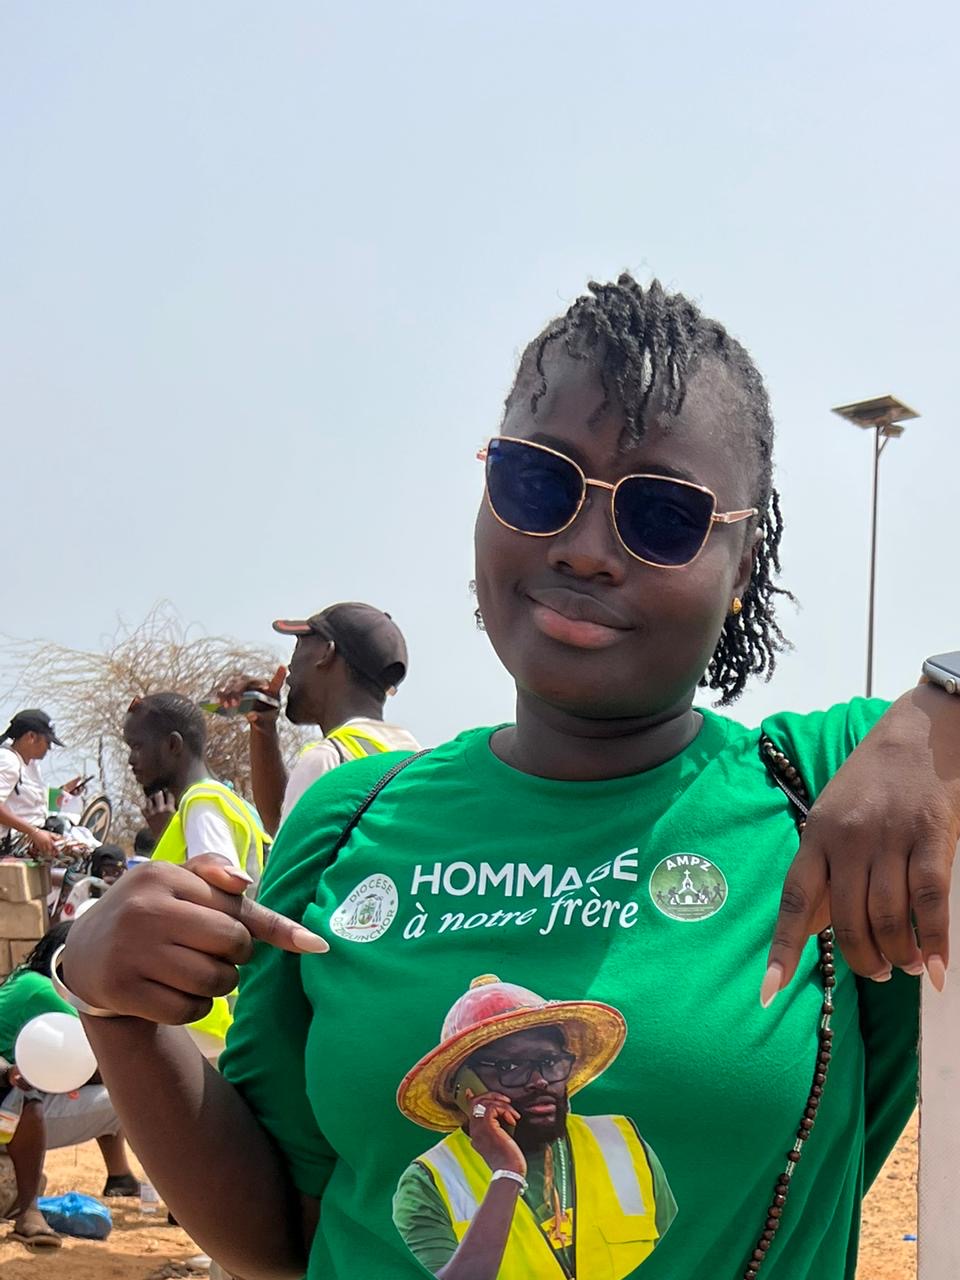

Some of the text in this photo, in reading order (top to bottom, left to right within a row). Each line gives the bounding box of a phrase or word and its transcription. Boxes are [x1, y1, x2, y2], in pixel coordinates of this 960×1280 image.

[410, 847, 639, 897] HOMMAGE
[665, 855, 712, 872] AMPZ
[403, 886, 640, 940] à notre frère
